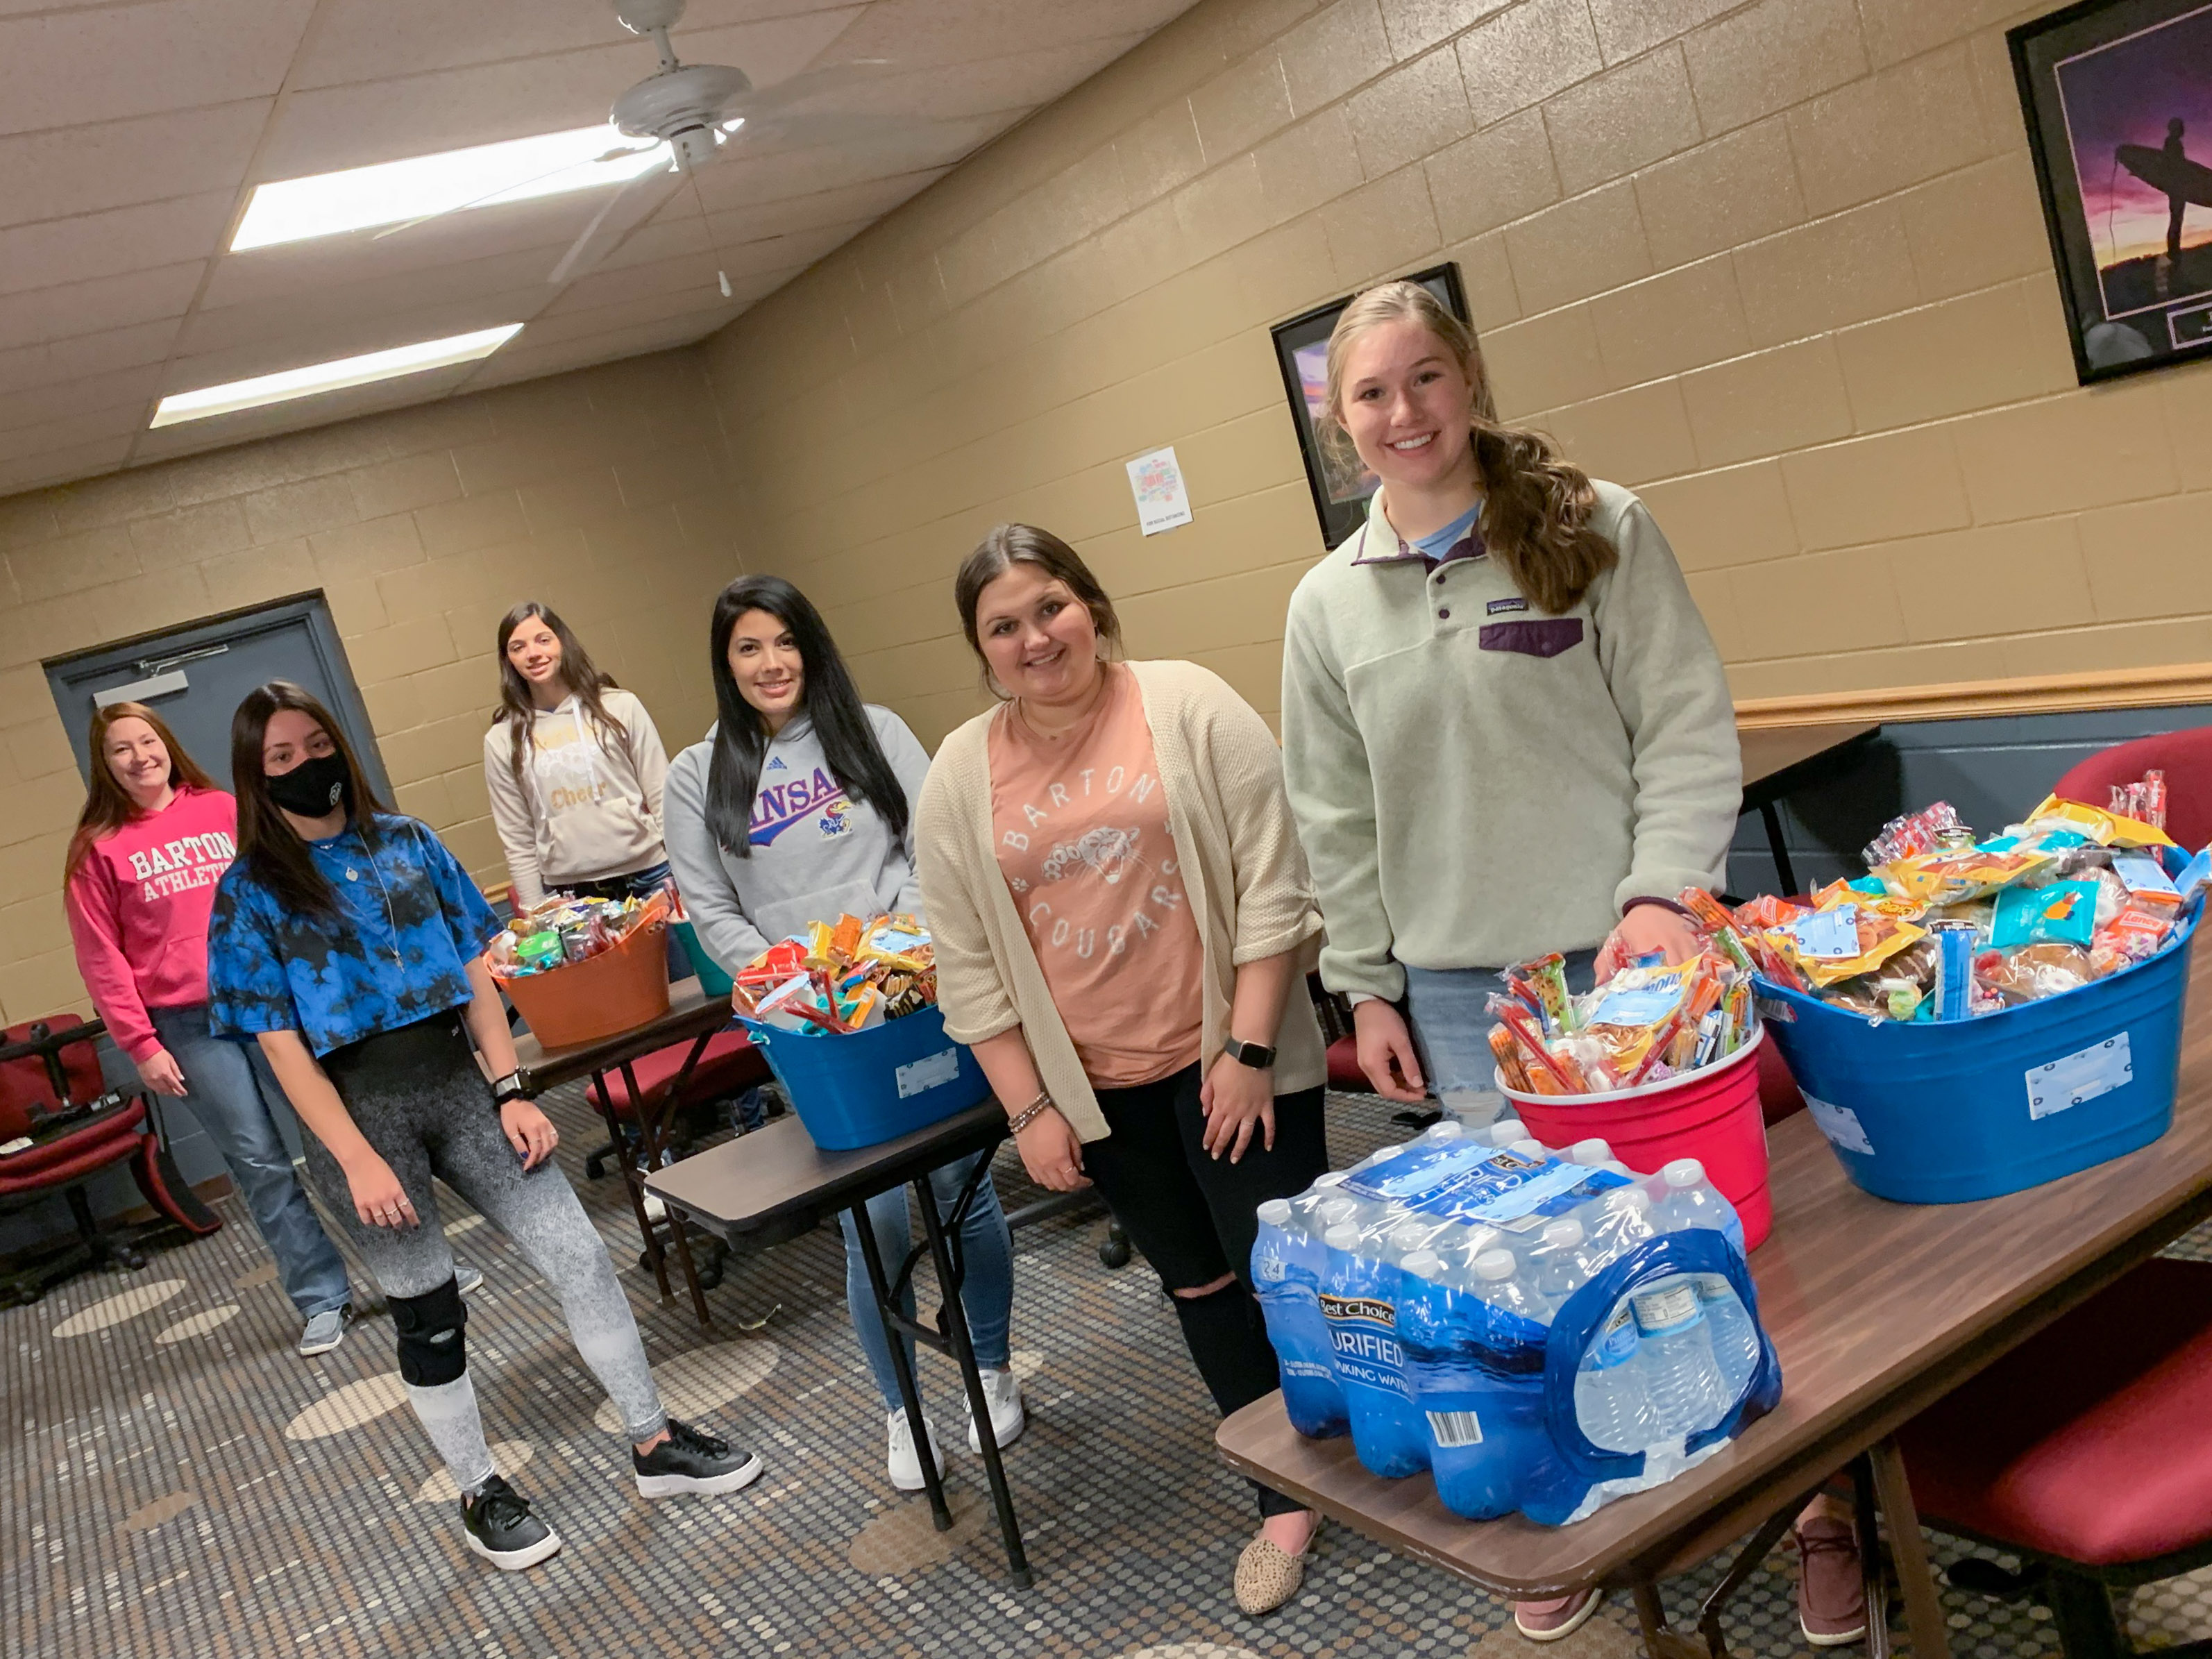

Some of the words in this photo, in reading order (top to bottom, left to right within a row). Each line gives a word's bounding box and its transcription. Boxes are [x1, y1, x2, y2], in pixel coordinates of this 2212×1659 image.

[1490, 603, 1523, 613] patagonia
[1003, 766, 1157, 852] BARTON
[128, 831, 237, 881] BARTON
[2124, 912, 2161, 928] Lance
[1344, 1302, 1395, 1324] Choice
[1328, 1329, 1403, 1367] URIFIED
[1335, 1358, 1376, 1382] NKING
